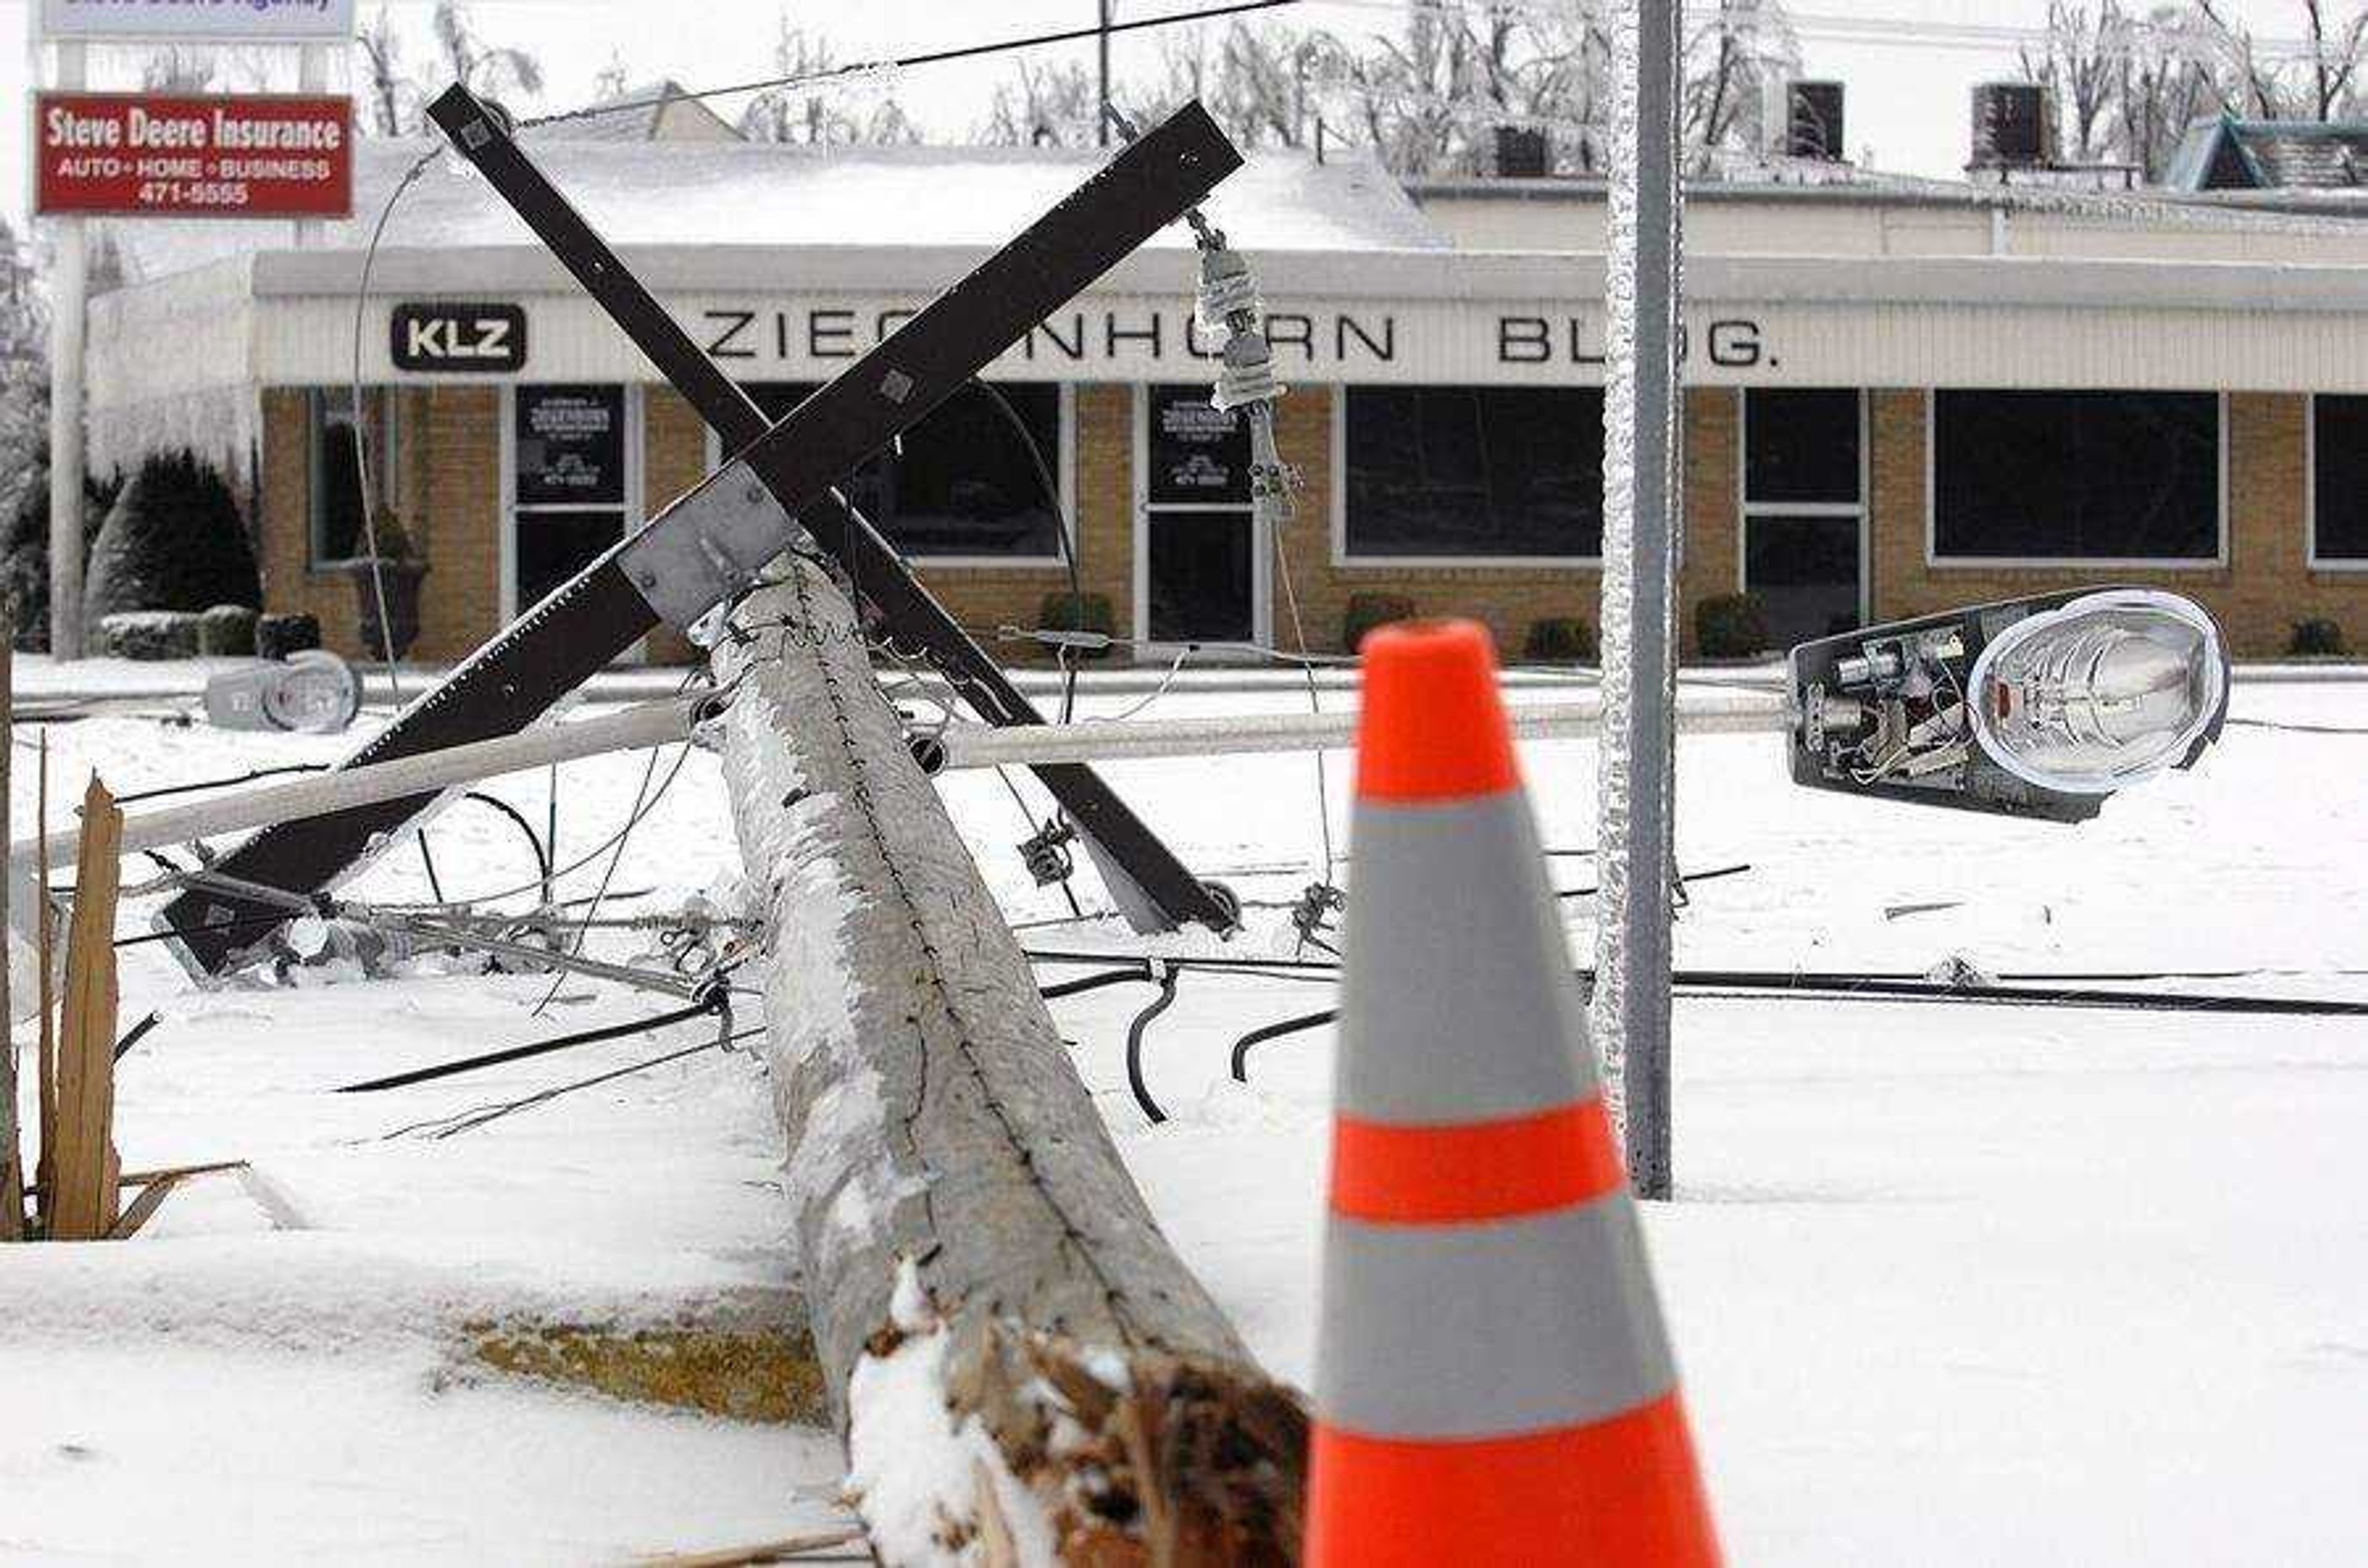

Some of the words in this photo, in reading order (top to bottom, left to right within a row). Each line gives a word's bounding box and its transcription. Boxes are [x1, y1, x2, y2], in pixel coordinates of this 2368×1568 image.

[47, 107, 120, 148] Steve
[128, 108, 207, 148] Deere
[214, 108, 341, 149] Insurance
[58, 158, 120, 178] AUTO
[137, 158, 202, 178] HOME
[220, 159, 330, 180] BUSINESS
[138, 184, 249, 204] 471-5555
[408, 318, 510, 357] KLZ
[704, 310, 1393, 361] ZIENHRN
[1498, 316, 1778, 367] BLG.
